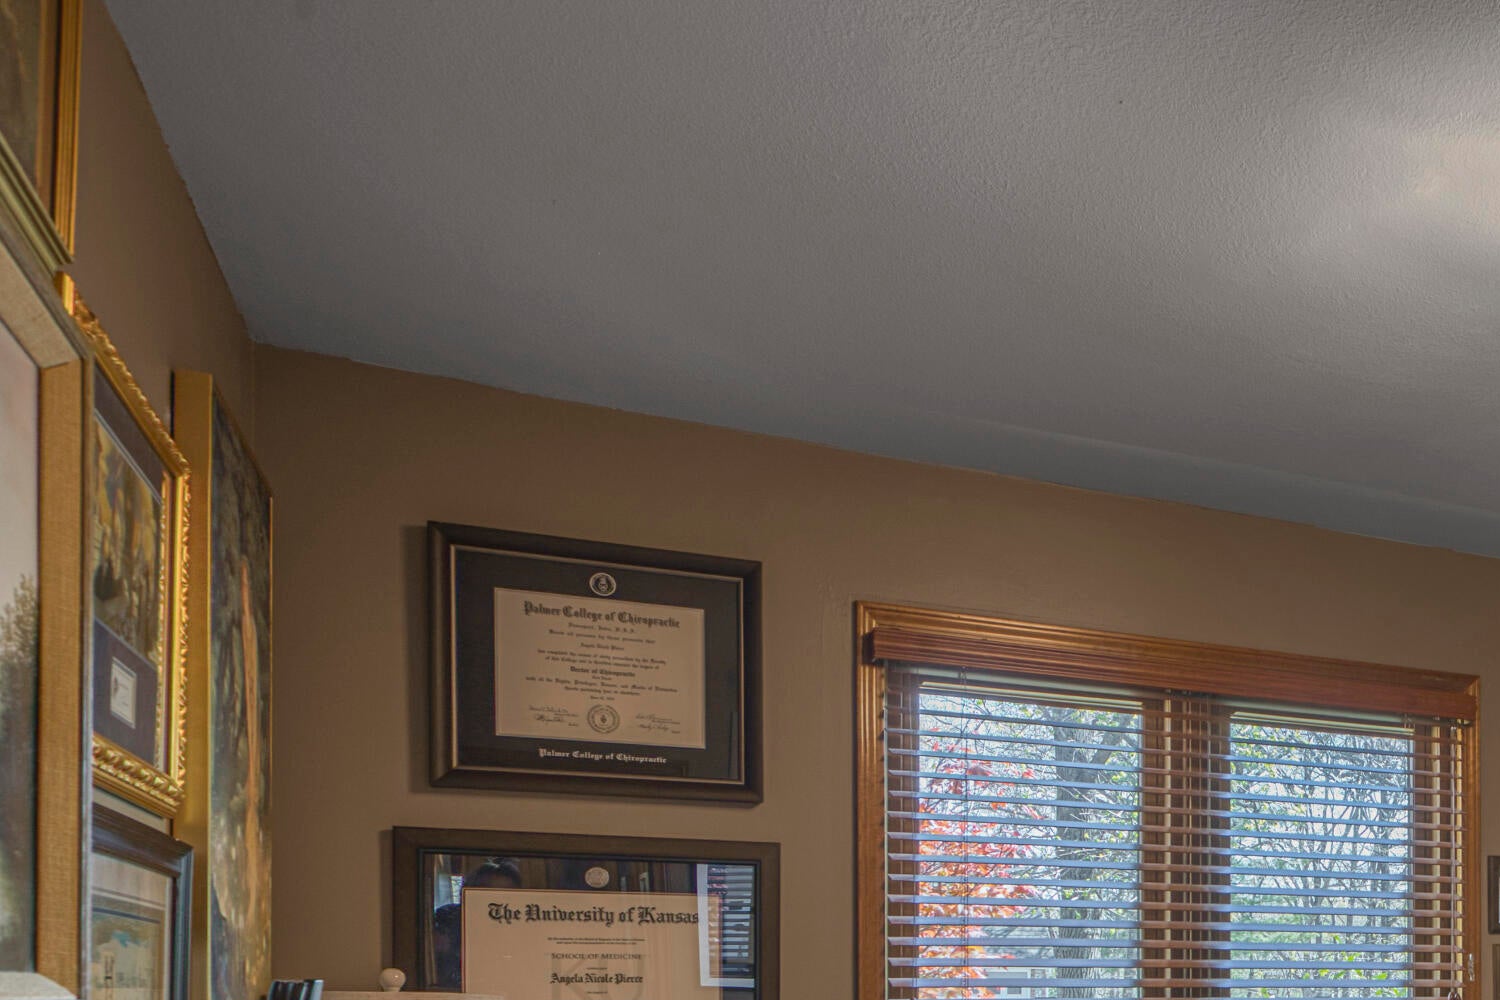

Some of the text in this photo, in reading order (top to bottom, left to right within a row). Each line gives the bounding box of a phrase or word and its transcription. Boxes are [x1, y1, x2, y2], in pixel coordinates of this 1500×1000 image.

[524, 601, 561, 616] Palmer
[563, 606, 598, 622] College
[600, 609, 614, 620] of
[618, 612, 680, 628] Chiropractic
[539, 748, 667, 764] Palmer College Chiropractic
[488, 903, 699, 926] The University of Kansas
[550, 973, 644, 985] Angela Pierce
